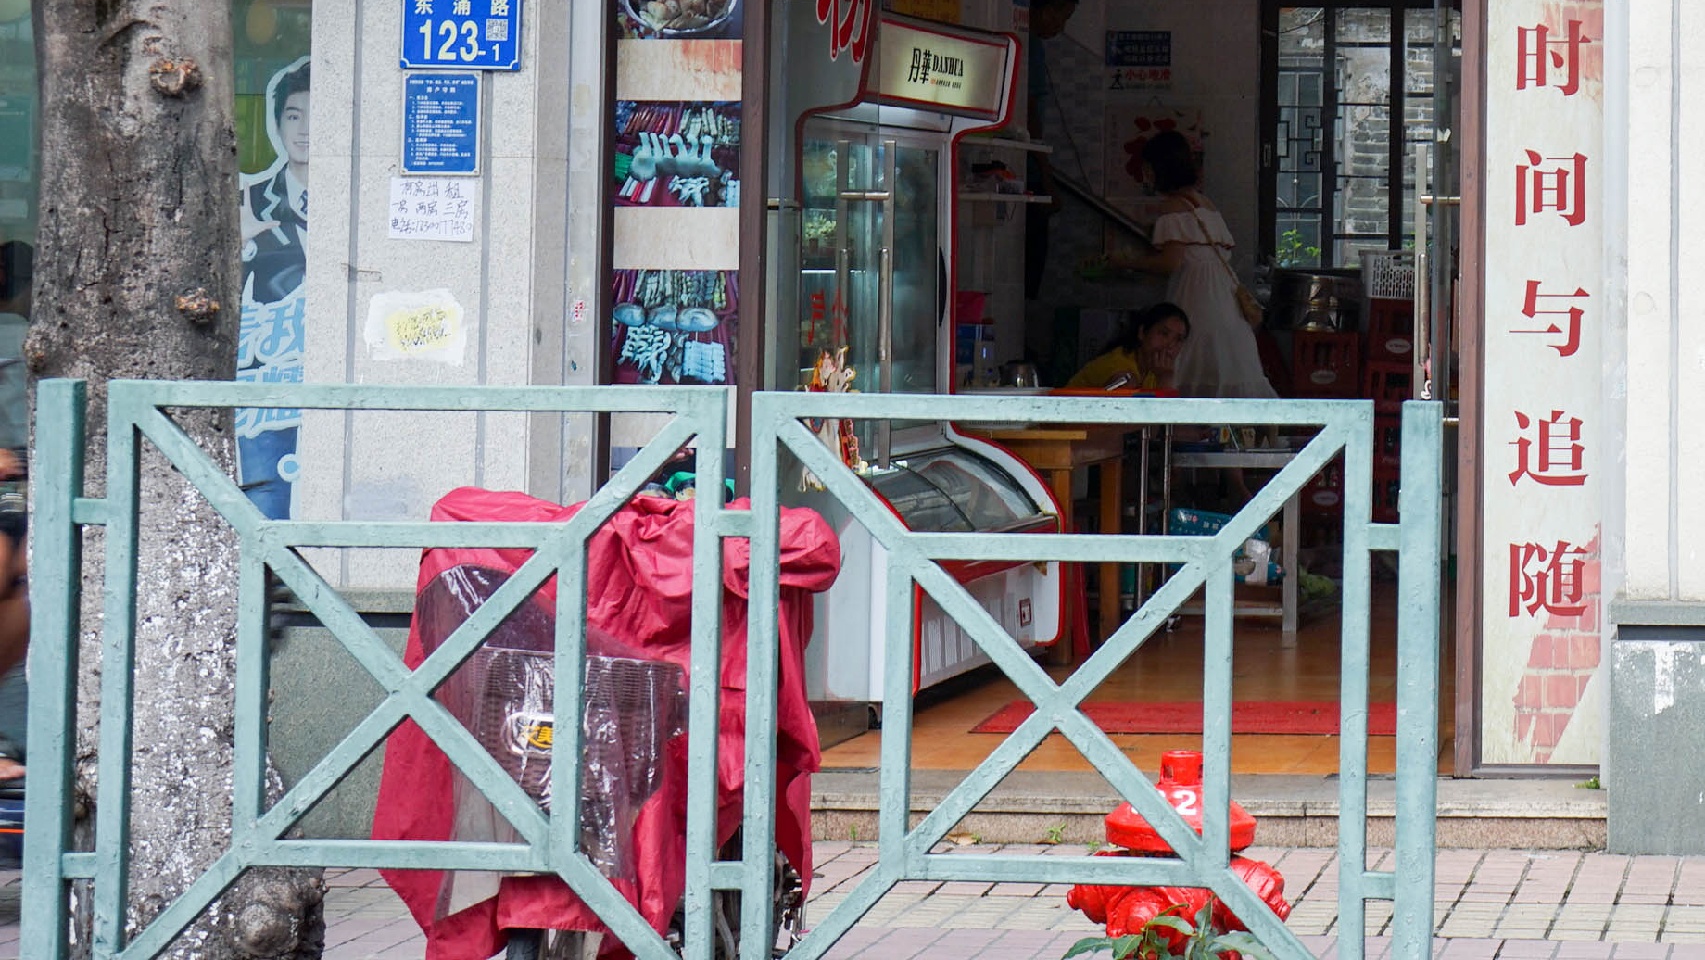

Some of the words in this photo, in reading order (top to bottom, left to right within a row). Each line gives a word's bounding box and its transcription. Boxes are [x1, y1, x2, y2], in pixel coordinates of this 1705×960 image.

[932, 54, 964, 77] DANHUA
[1509, 19, 1592, 618] 时间与追随
